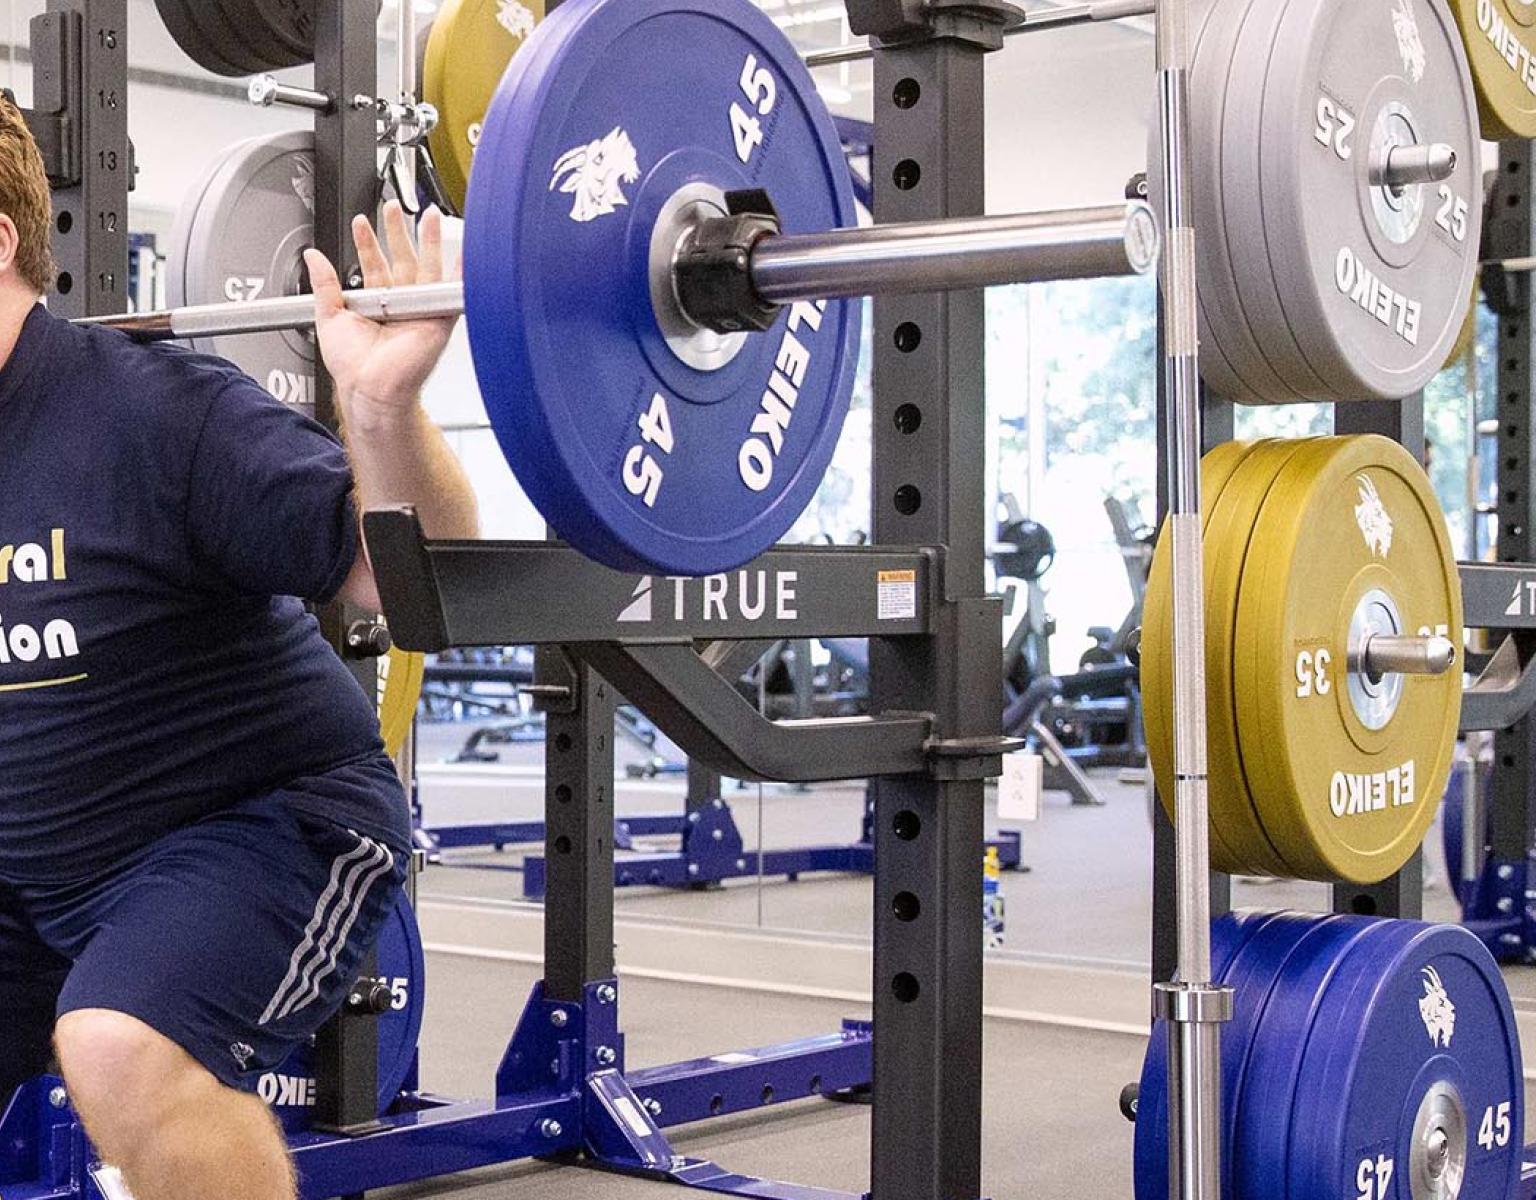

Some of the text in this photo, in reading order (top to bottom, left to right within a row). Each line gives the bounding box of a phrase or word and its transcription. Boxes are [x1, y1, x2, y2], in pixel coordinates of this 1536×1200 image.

[98, 29, 117, 49] 15
[729, 53, 776, 162] 45
[1314, 97, 1356, 162] 25
[98, 151, 117, 171] 13
[98, 212, 117, 232] 12
[1435, 184, 1468, 242] 25
[99, 272, 115, 292] 11
[1335, 246, 1422, 346] ELEIKO
[738, 300, 827, 491] LEIKO
[623, 392, 674, 508] 45
[666, 570, 798, 620] TRUE
[1296, 648, 1331, 698] 35
[1330, 760, 1414, 818] ELEIKO
[371, 976, 409, 1010] 5
[1478, 1101, 1511, 1150] 45
[1356, 1153, 1395, 1200] 45
